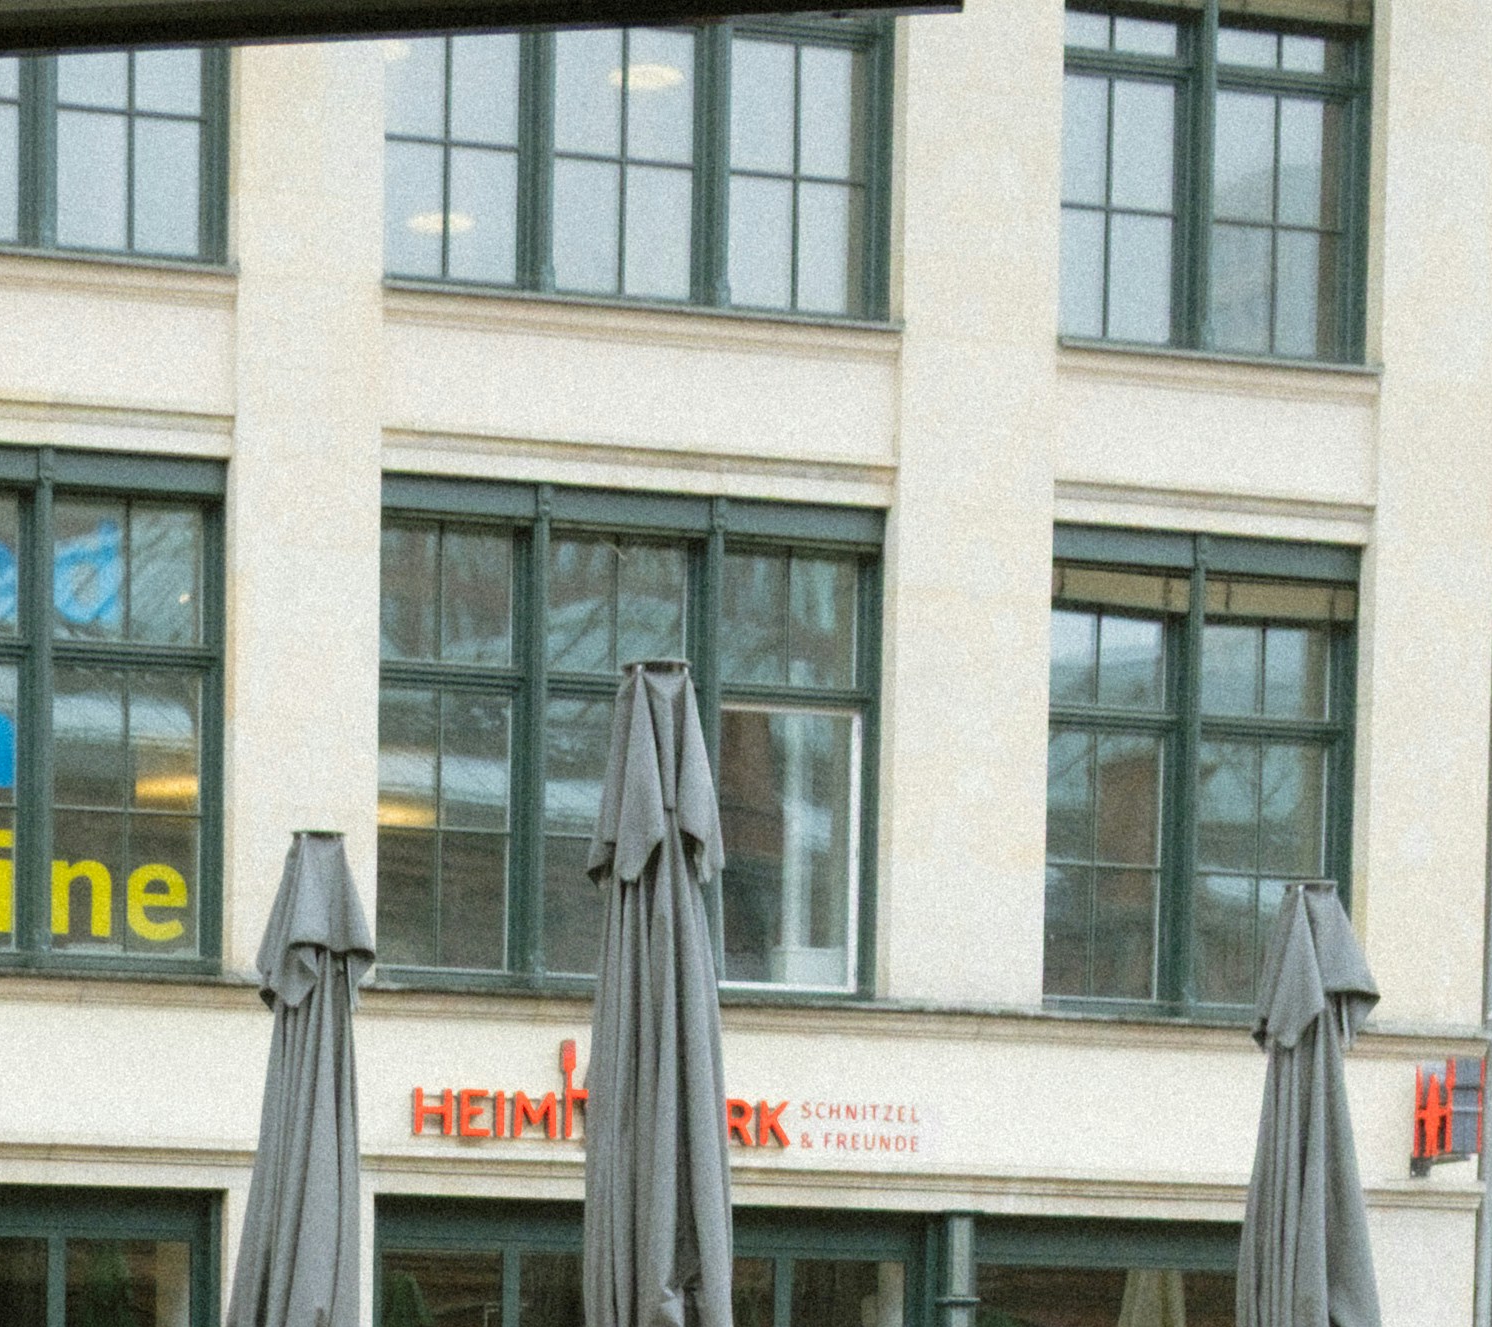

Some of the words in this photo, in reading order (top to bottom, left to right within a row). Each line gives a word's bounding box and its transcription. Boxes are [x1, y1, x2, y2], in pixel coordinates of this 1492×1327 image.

[412, 1046, 791, 1148] HEIMRK
[800, 1101, 919, 1124] SCHNITZEL
[800, 1132, 814, 1150] &
[823, 1132, 919, 1154] FREUNDE
